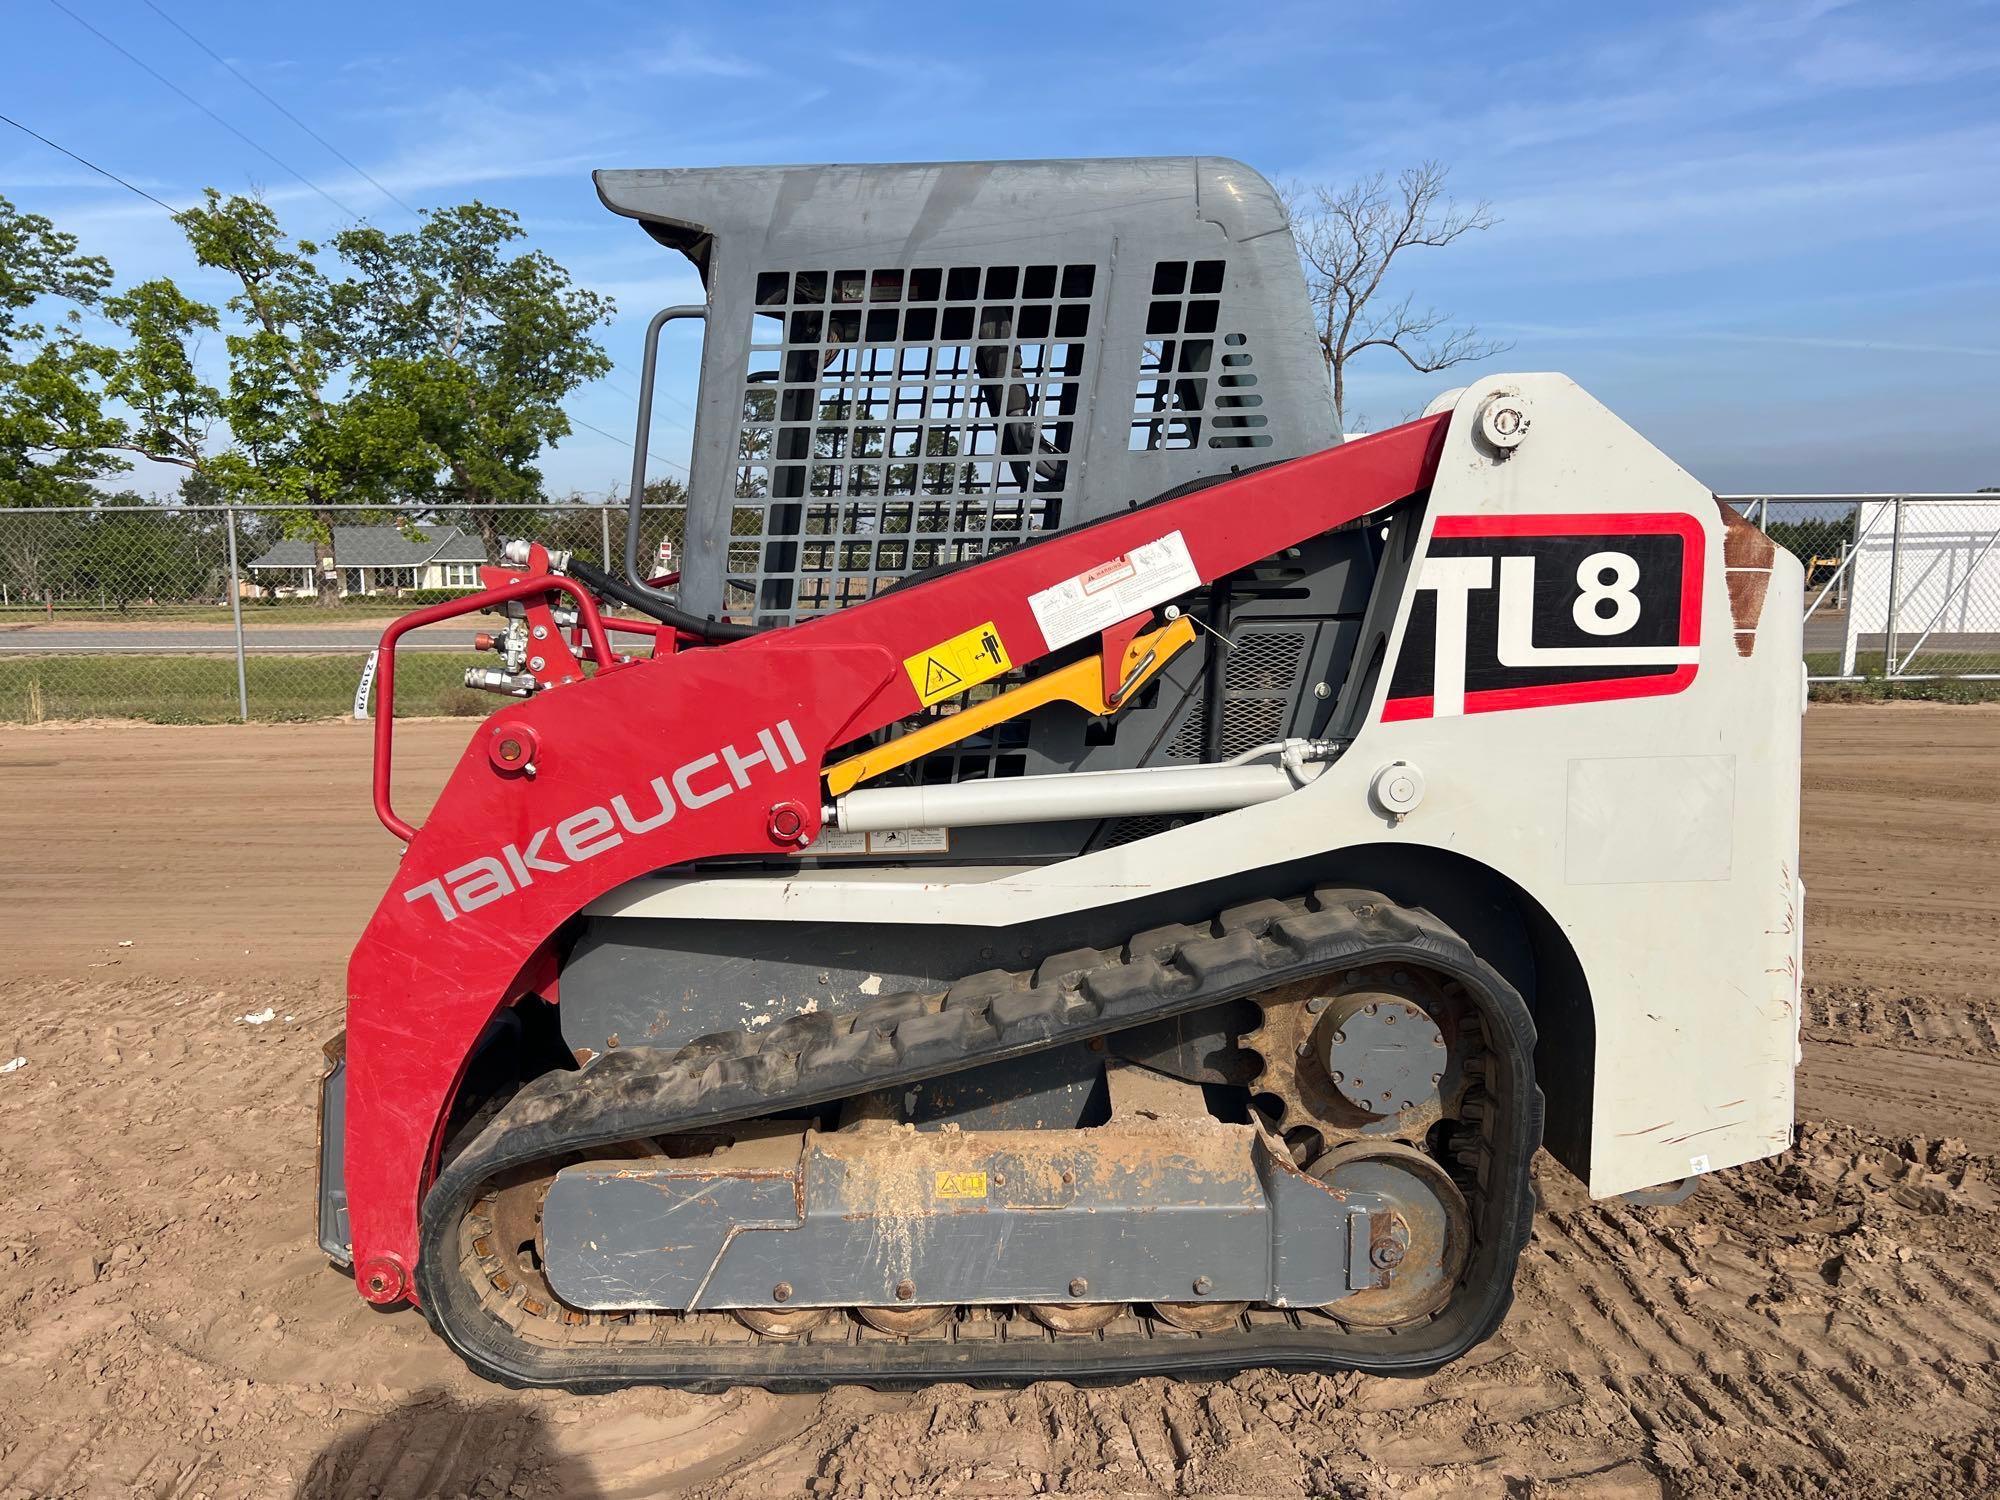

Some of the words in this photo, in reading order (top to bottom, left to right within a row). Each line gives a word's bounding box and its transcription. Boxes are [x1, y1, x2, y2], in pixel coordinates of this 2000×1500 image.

[1096, 562, 1122, 577] WARNING
[1416, 552, 1700, 718] TL8
[358, 664, 374, 710] 219379
